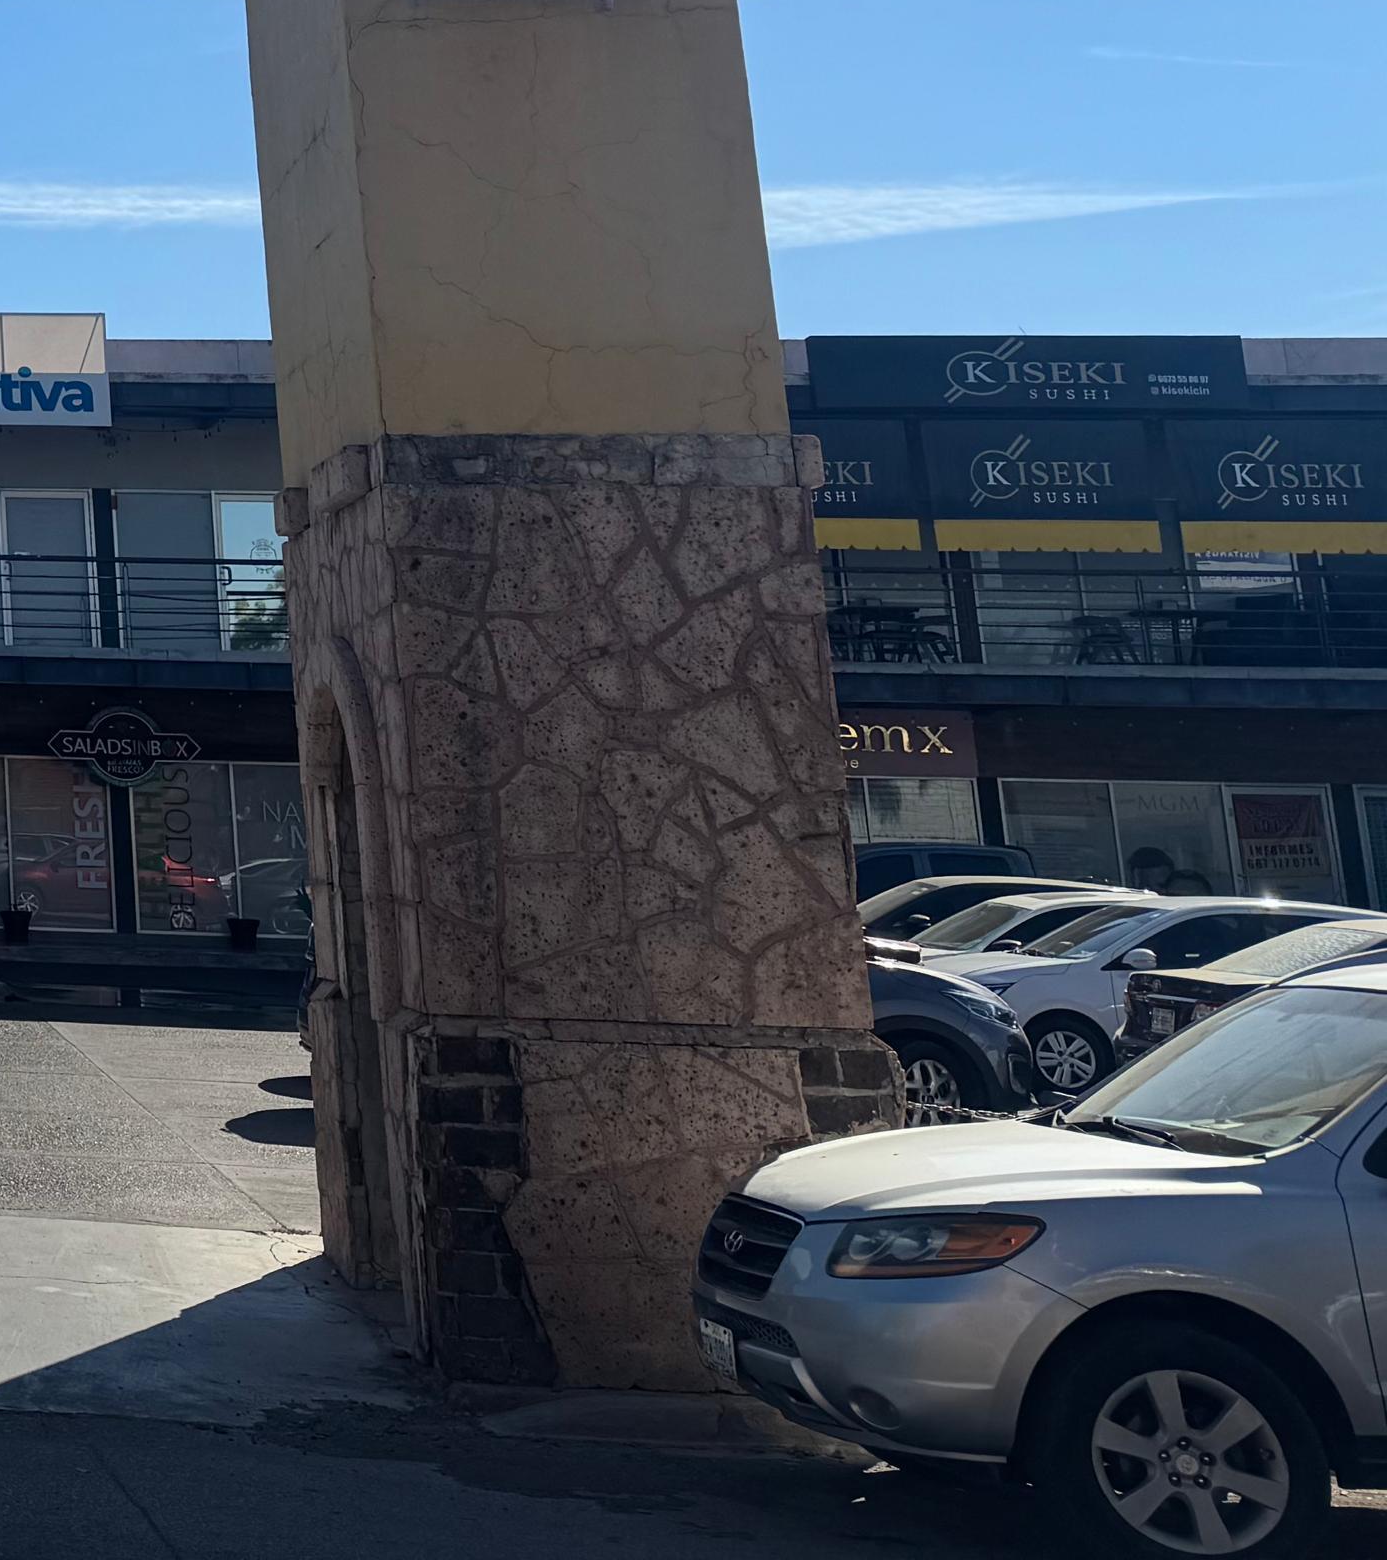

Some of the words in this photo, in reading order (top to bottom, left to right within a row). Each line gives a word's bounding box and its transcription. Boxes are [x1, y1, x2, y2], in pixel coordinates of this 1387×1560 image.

[963, 360, 1128, 385] KISEKI
[1029, 389, 1111, 401] SUSHI
[984, 461, 1115, 487] KISEKI
[1231, 463, 1365, 489] KISEKI
[1033, 491, 1099, 504] SUSHI
[1282, 494, 1348, 506] SUSHI
[1137, 794, 1201, 813] MGM
[1249, 843, 1314, 857] INFORMES
